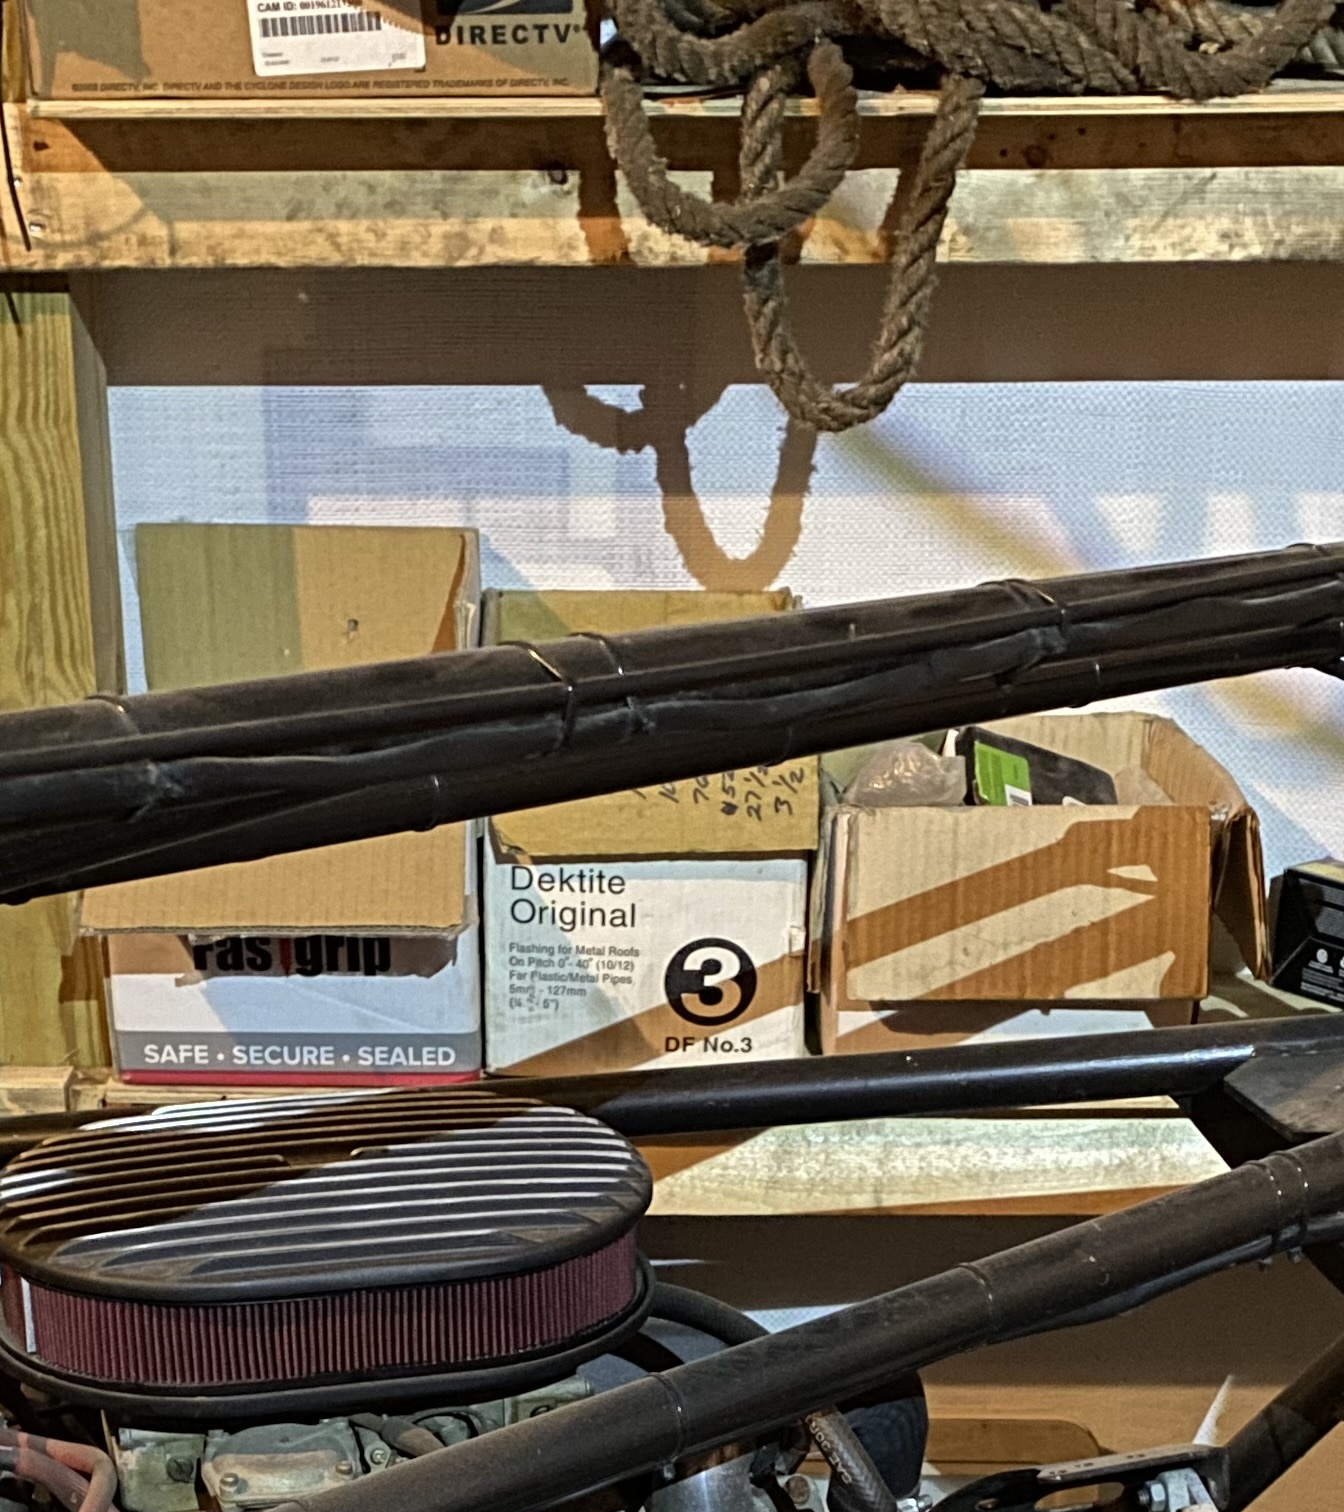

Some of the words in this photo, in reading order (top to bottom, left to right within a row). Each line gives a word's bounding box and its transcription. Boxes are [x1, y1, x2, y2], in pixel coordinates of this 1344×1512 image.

[257, 2, 281, 12] CAM
[436, 23, 572, 45] DIRECTV
[244, 81, 287, 90] CYCLONE
[372, 80, 430, 89] REGISTERED
[433, 79, 493, 88] TRADEMARKS
[511, 866, 626, 895] Dektite
[510, 898, 636, 932] Original
[509, 942, 555, 957] Flashing
[558, 944, 572, 954] for
[576, 945, 605, 956] Metal
[608, 946, 640, 957] Roofs
[509, 956, 525, 967] On
[528, 956, 555, 968] Pitch
[596, 960, 635, 972] (10/12)
[509, 970, 527, 981] For
[602, 973, 633, 985] Pipes
[680, 947, 742, 1018] 3
[548, 985, 587, 997] 127mm
[665, 1037, 696, 1053] DF
[703, 1037, 753, 1053] No.3
[144, 1045, 209, 1065] SAFE
[233, 1046, 335, 1066] SECURE
[358, 1046, 456, 1067] SEALED
